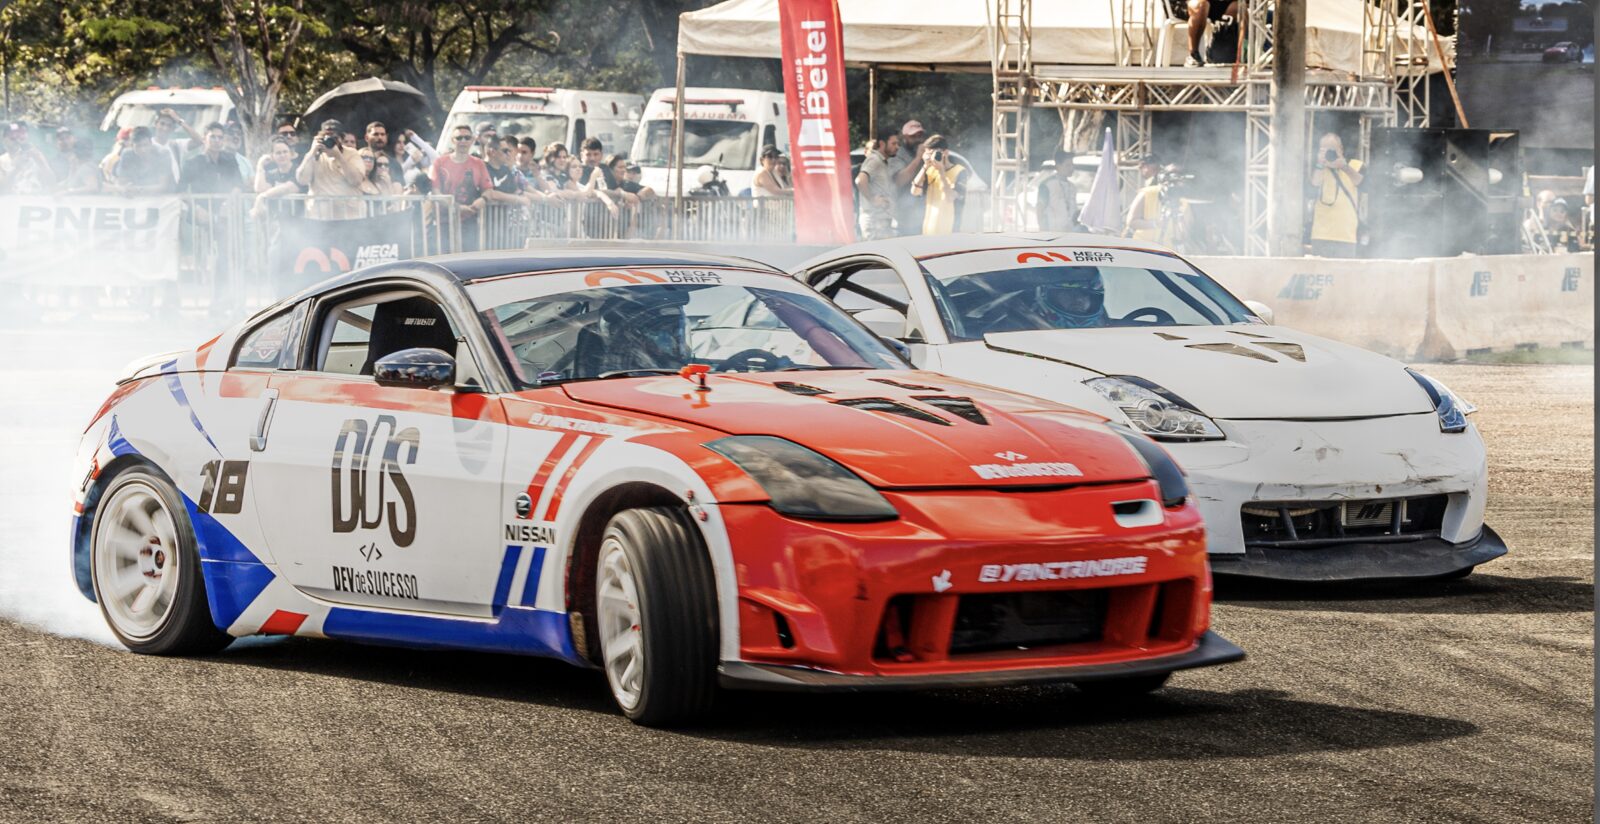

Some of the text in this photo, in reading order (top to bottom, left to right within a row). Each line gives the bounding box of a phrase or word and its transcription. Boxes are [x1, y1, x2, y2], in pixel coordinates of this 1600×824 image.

[800, 20, 830, 115] Betel
[18, 206, 160, 230] PNEU
[356, 243, 399, 258] MEGA
[669, 276, 722, 284] DRIFT
[196, 459, 250, 515] 18
[505, 524, 556, 544] NISSAN
